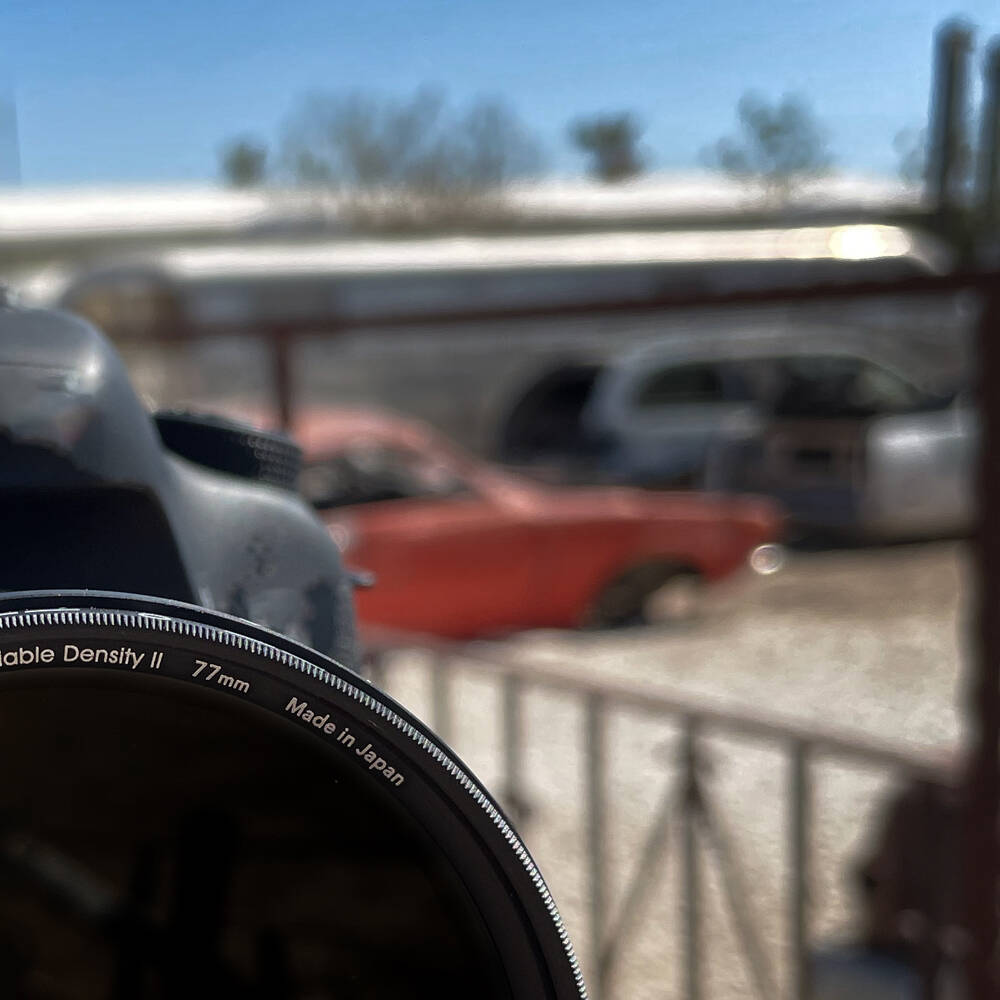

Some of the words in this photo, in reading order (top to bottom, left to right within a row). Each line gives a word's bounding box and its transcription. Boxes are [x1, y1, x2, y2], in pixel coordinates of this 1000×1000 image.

[63, 644, 145, 670] Density
[150, 651, 164, 669] II
[191, 659, 250, 694] 77mm
[284, 696, 336, 735] Made
[336, 727, 356, 748] in
[355, 743, 404, 787] Japan
